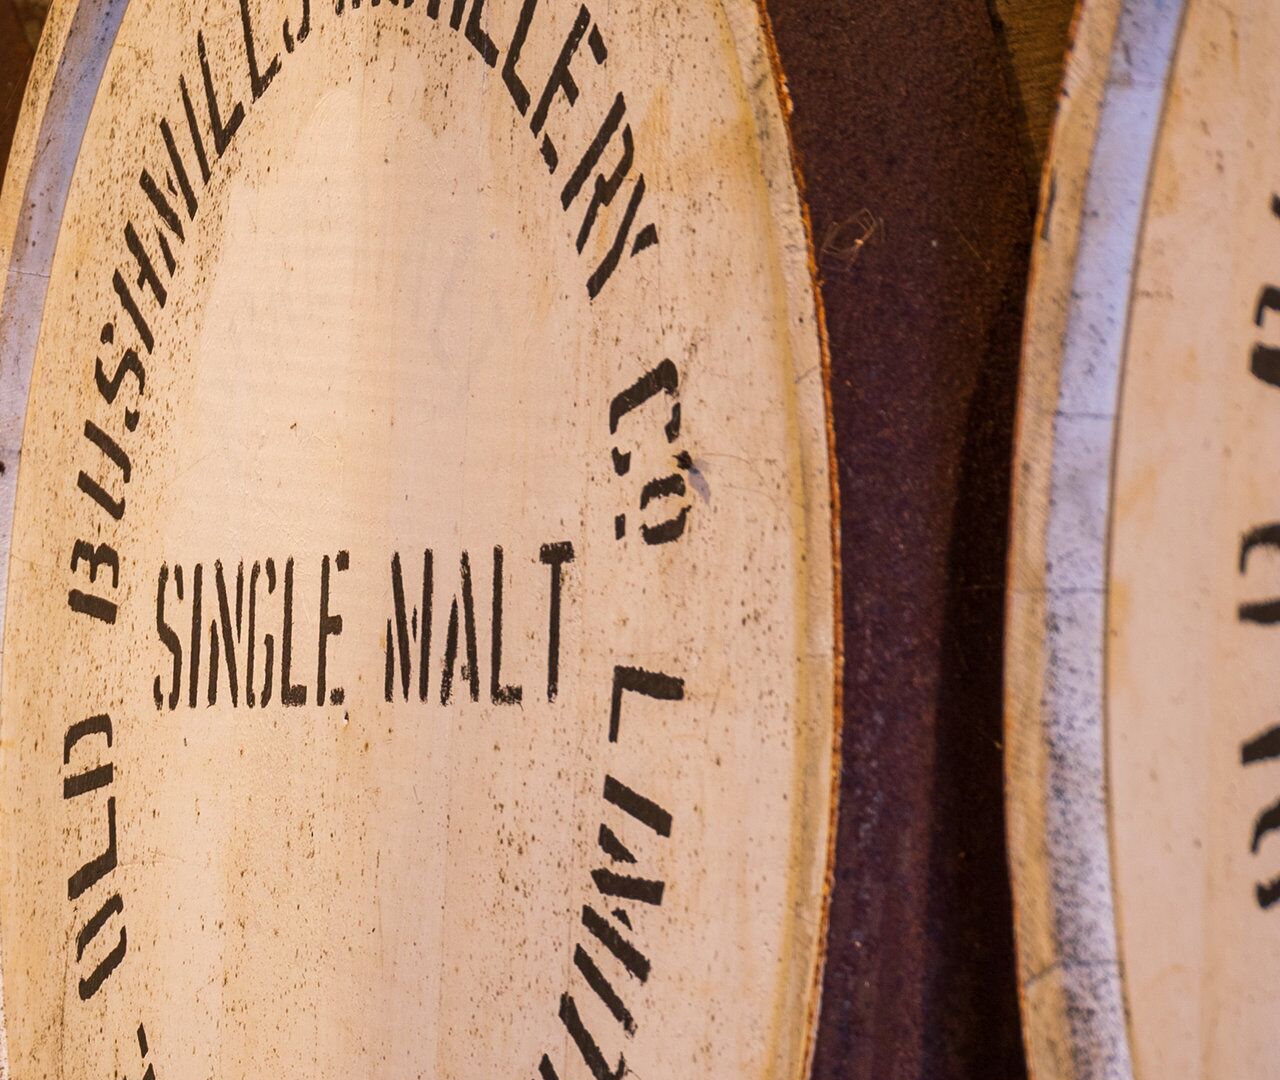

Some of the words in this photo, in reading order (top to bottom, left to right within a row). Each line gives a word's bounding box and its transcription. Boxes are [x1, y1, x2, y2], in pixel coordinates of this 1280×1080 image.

[153, 549, 350, 712] SINGLE
[384, 541, 575, 707] MALT
[63, 713, 128, 1001] OLD
